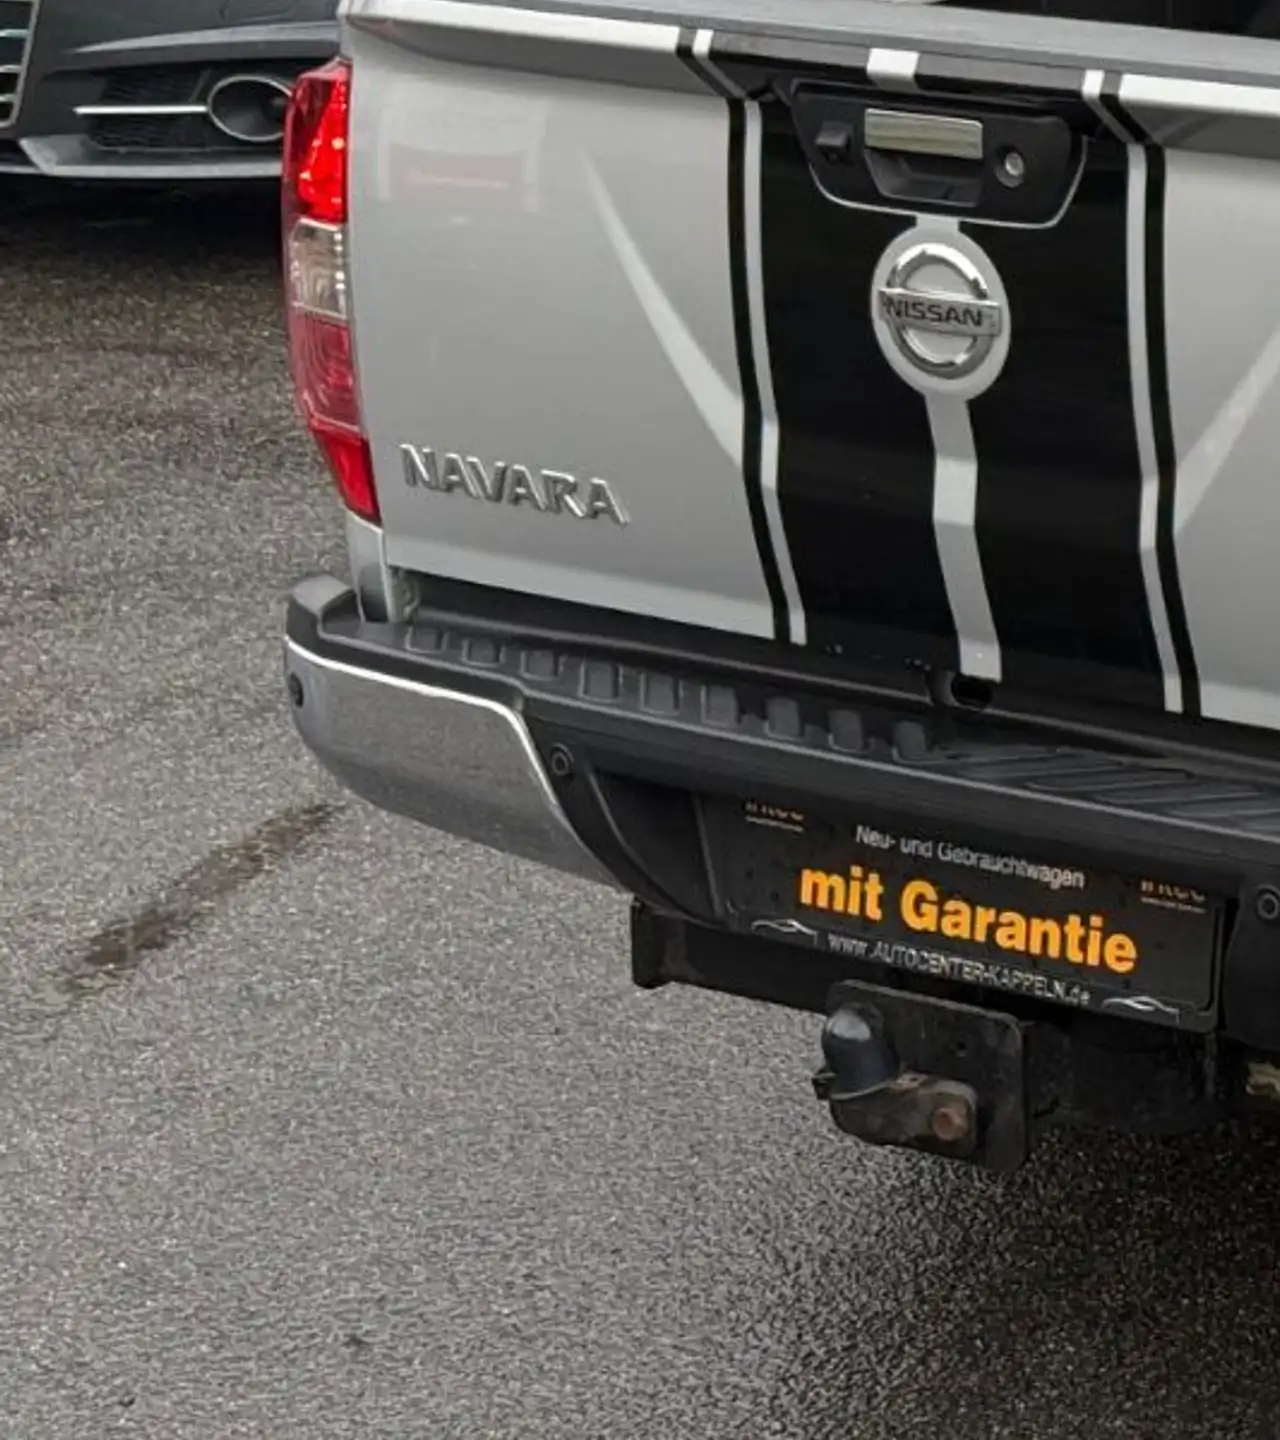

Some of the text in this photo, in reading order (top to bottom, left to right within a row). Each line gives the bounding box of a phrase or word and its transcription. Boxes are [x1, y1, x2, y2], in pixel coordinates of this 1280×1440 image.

[886, 299, 983, 327] NISSAN
[399, 442, 631, 525] NAVARA
[856, 824, 1085, 892] Neu- und Gebrauchtwagen
[799, 865, 1138, 974] mit Garantie
